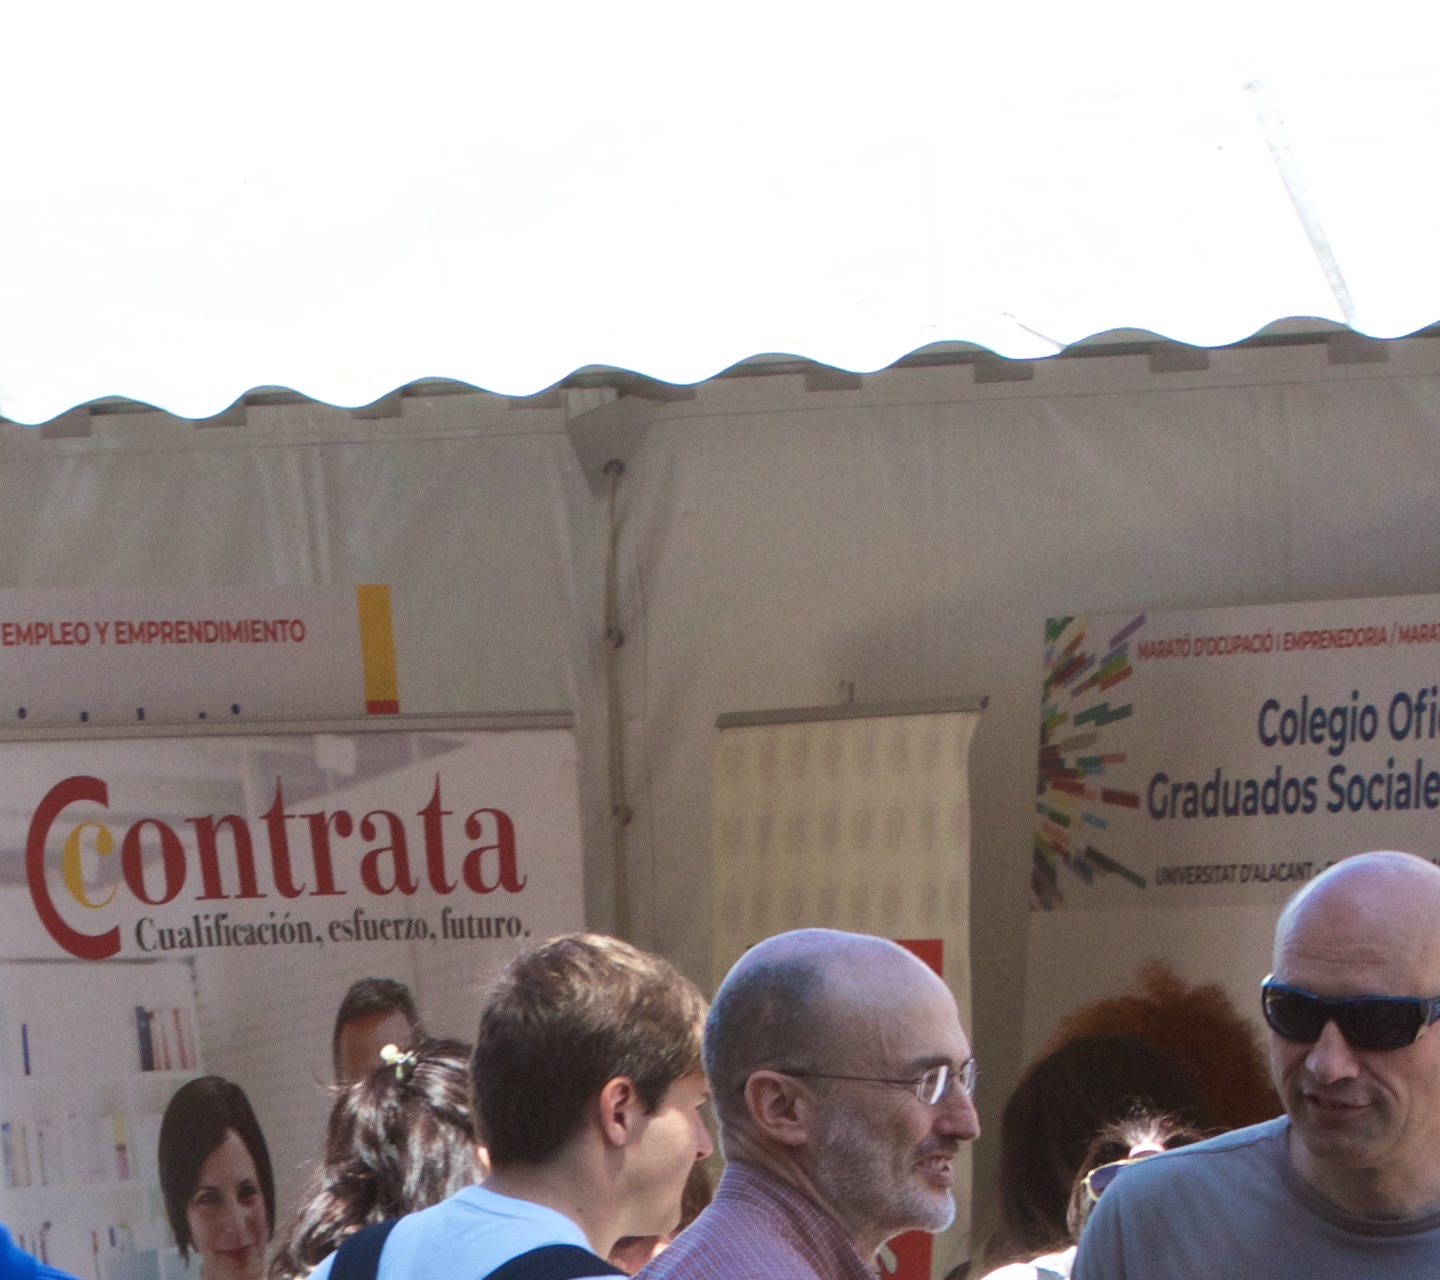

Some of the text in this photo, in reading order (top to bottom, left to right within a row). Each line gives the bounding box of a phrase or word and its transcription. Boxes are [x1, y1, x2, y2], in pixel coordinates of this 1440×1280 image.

[3, 622, 90, 646] EMPLEO
[95, 621, 113, 643] Y
[116, 619, 306, 644] EMPRENDIMIENTO
[1283, 626, 1387, 652] EMPRENEDORIA
[1258, 691, 1378, 755] Colegio
[1147, 765, 1318, 821] Graduados
[1155, 864, 1237, 886] UNIVERSITAT
[135, 906, 532, 953] Cualificación, esfuerzo, futuro.
